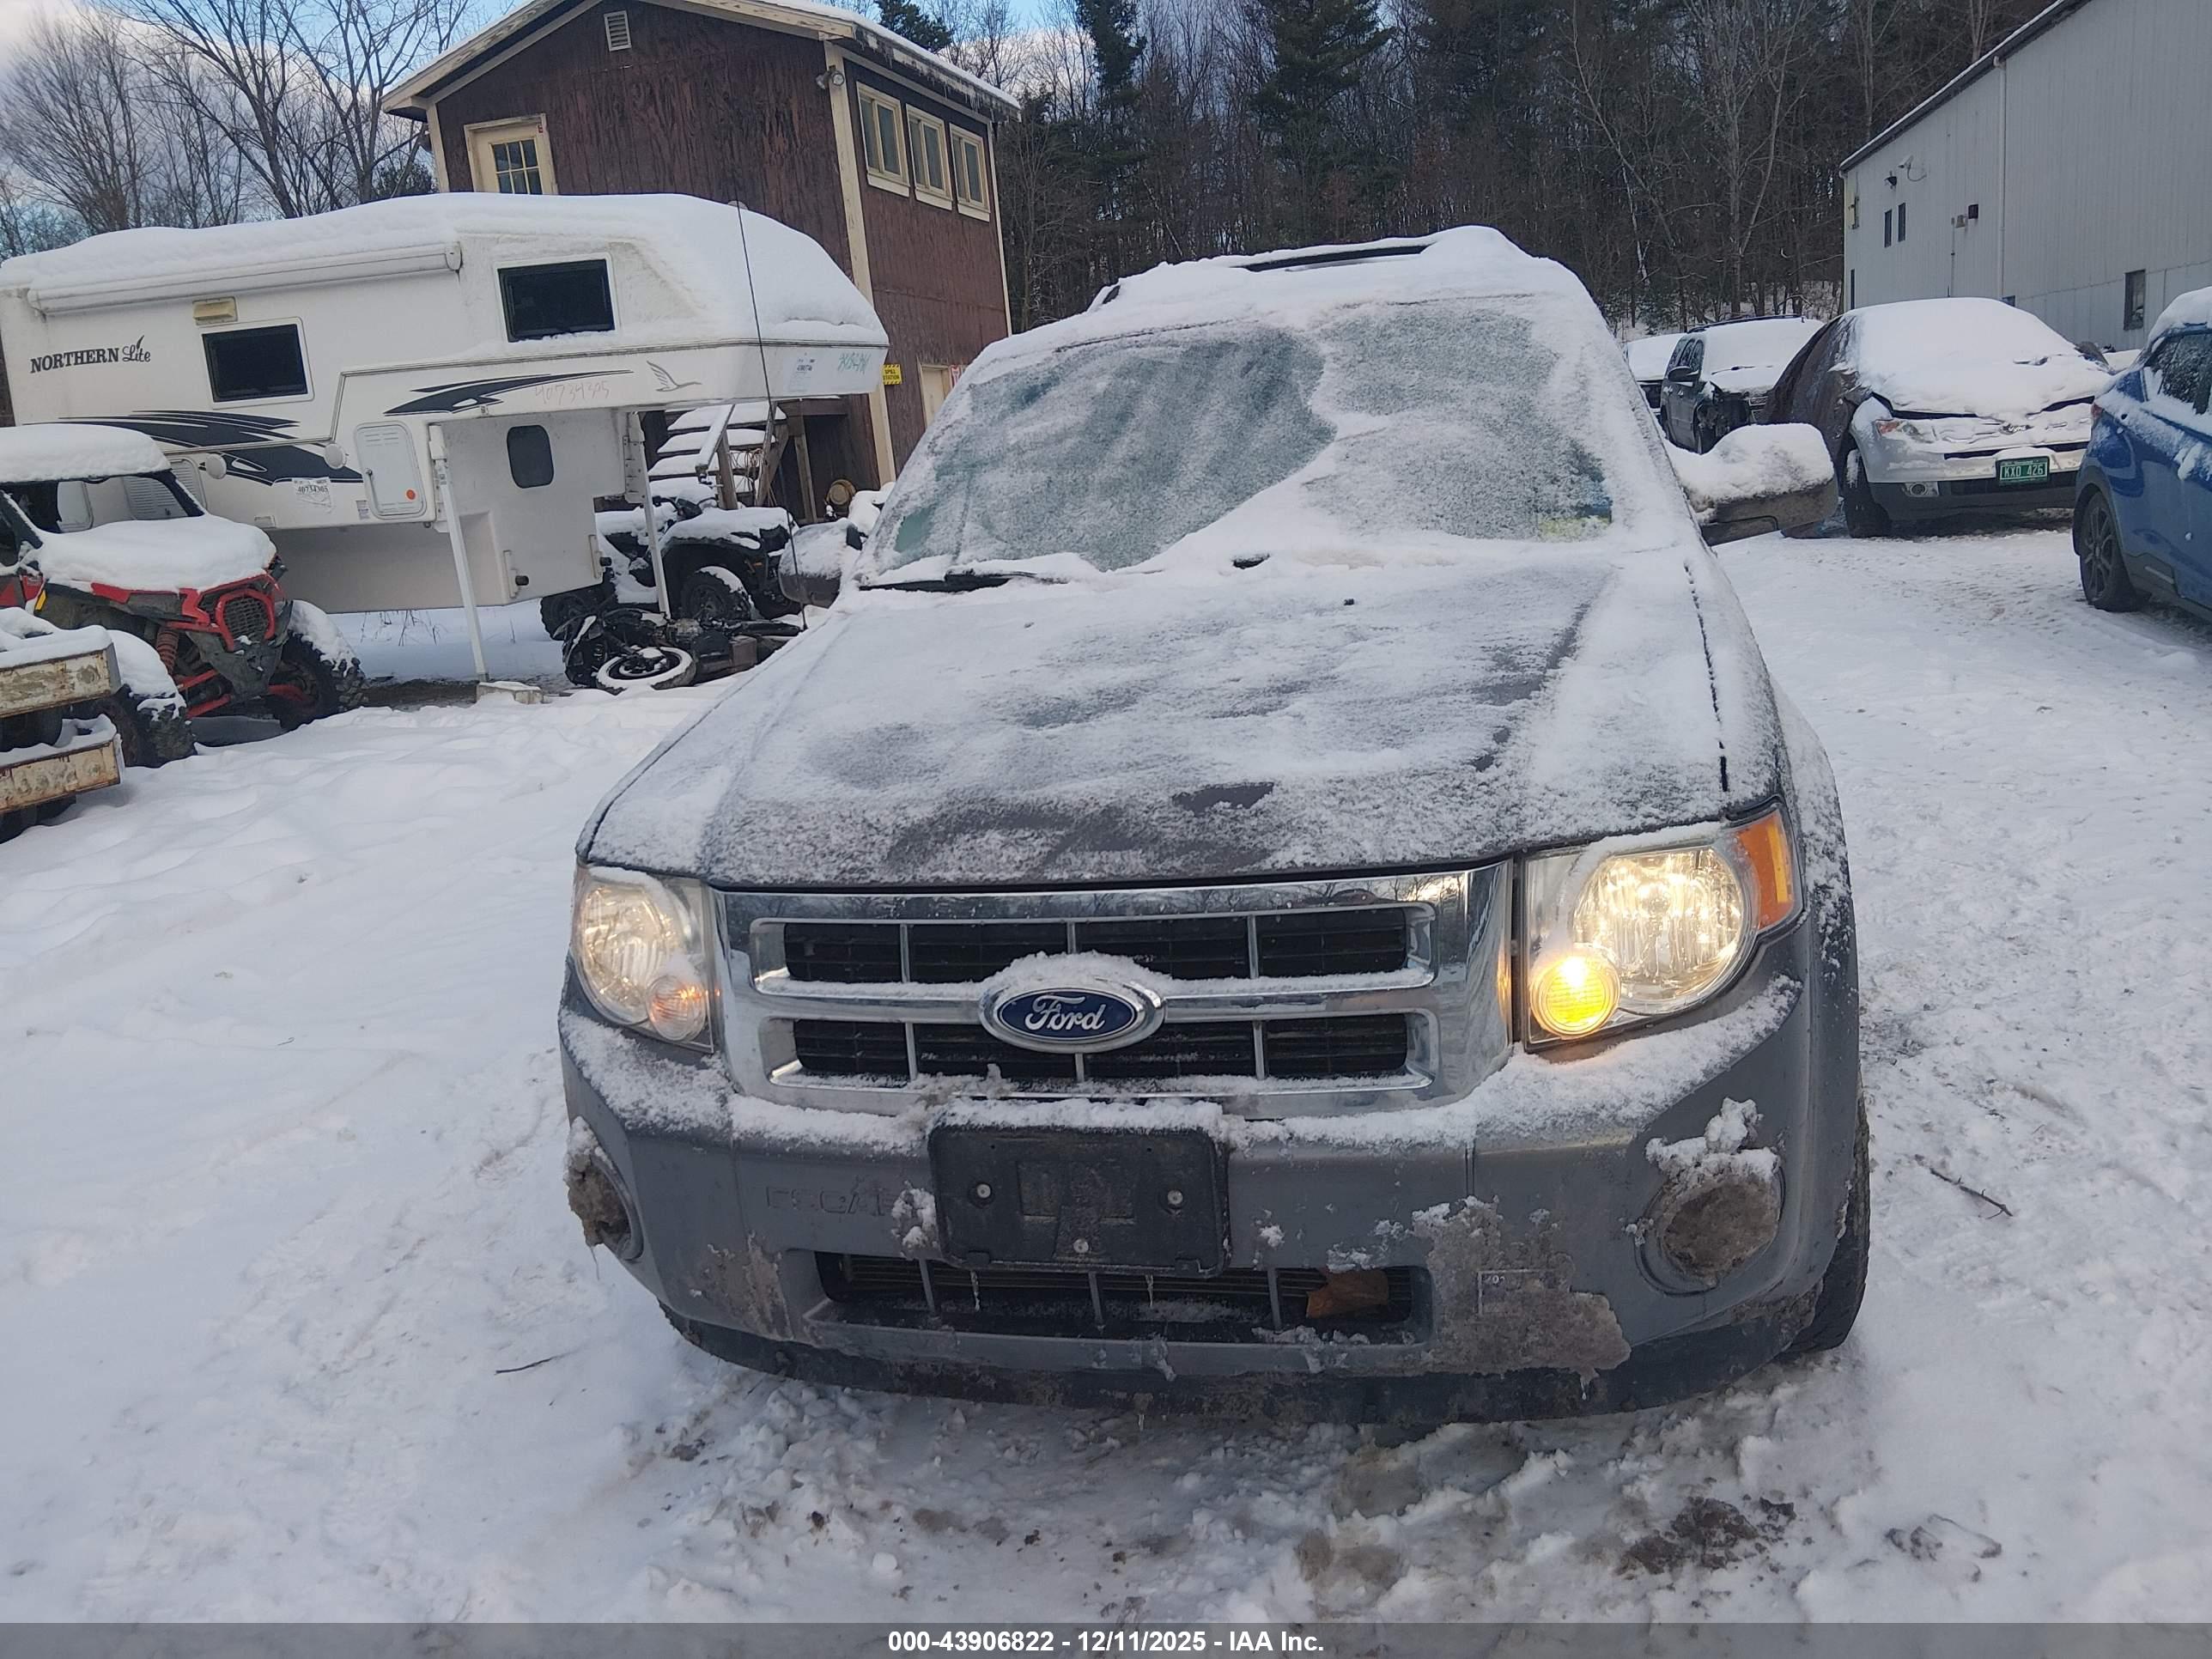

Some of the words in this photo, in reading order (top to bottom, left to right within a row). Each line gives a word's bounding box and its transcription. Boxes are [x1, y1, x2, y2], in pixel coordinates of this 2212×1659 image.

[30, 347, 119, 374] NORTHERN
[122, 335, 151, 362] Lite
[2027, 464, 2044, 476] 426
[1024, 994, 1107, 1030] Ford
